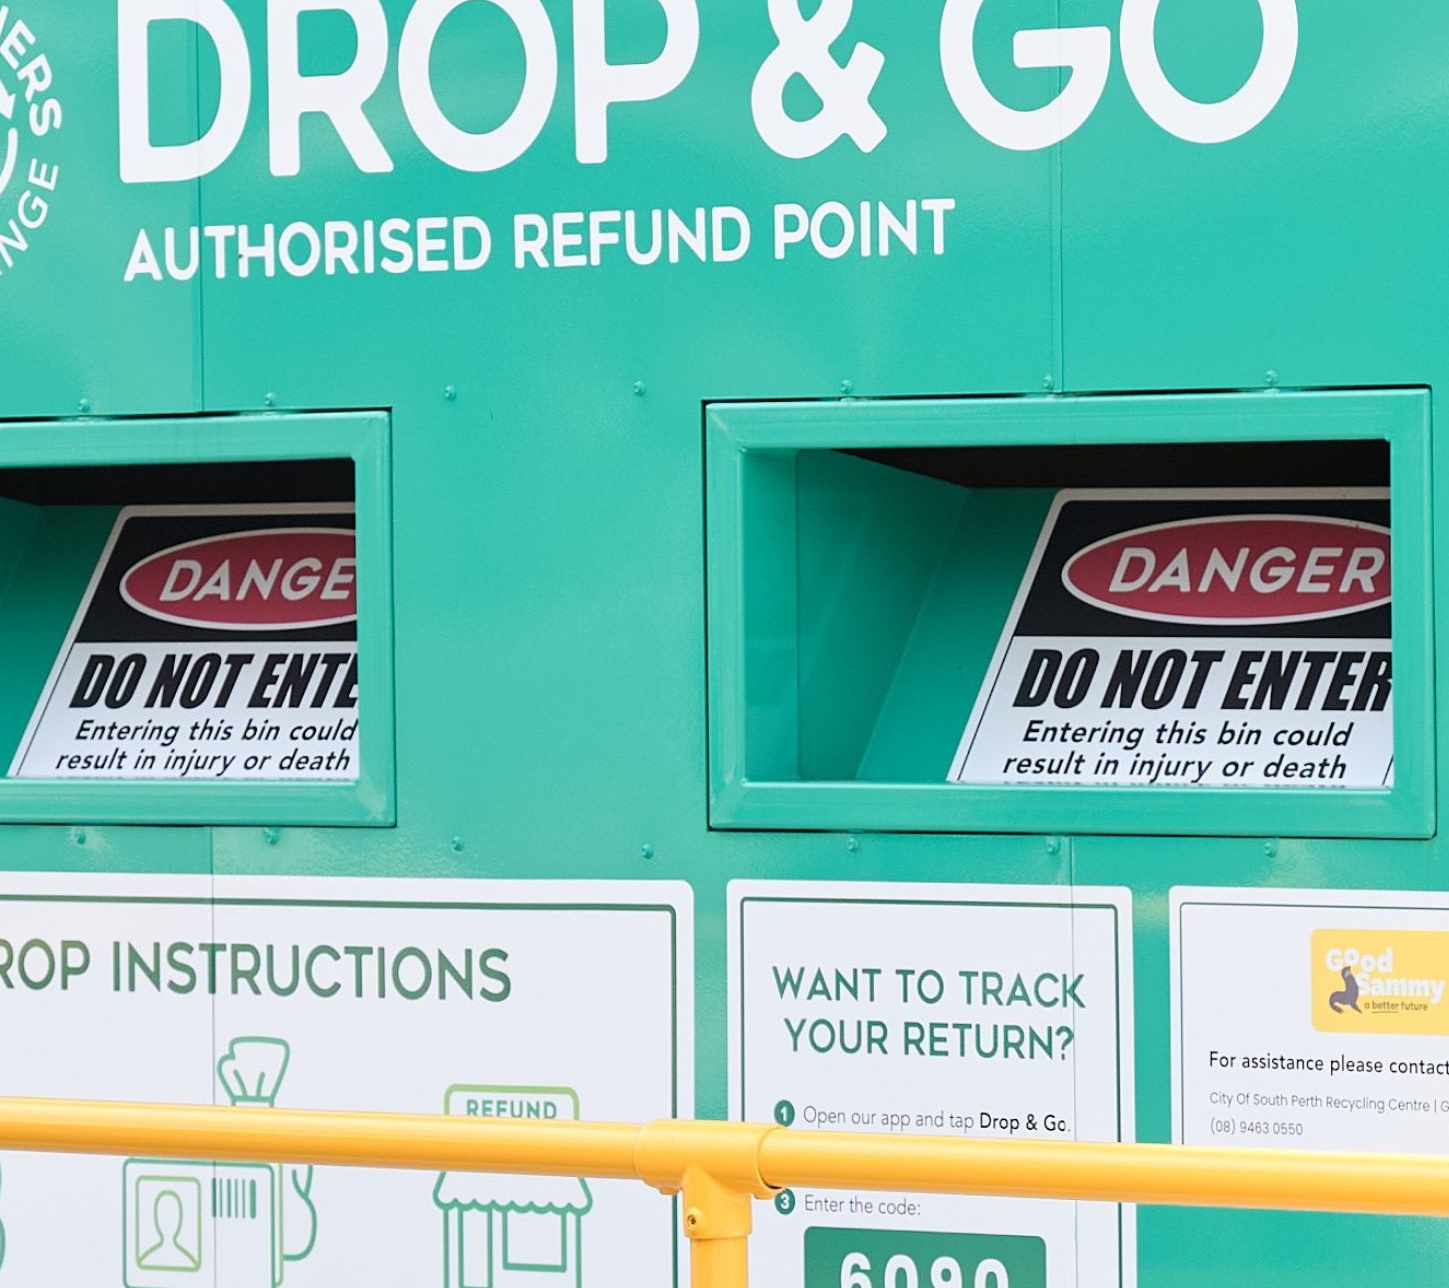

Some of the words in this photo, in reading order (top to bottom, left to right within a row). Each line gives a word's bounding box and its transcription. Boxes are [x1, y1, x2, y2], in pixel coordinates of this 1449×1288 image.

[124, 216, 491, 281] AUTHORISED
[514, 206, 750, 268] REFUND
[774, 199, 955, 259] POINT
[159, 558, 355, 601] DANGE
[1109, 547, 1384, 593] DANGER
[69, 653, 147, 709] DO
[145, 653, 253, 709] NOT
[1013, 649, 1100, 709] DO
[1100, 649, 1225, 710] NOT
[1221, 651, 1392, 711] ENTER
[76, 719, 180, 745] Entering
[189, 718, 233, 740] this
[242, 719, 280, 740] bin
[290, 718, 358, 740] could
[1023, 720, 1144, 750] Entering
[1156, 720, 1207, 744] this
[1217, 721, 1261, 745] bin
[1274, 722, 1354, 746] could
[1003, 752, 1085, 775] result
[1094, 752, 1118, 774] in
[1130, 753, 1212, 783] injury
[1223, 761, 1254, 777] or
[1264, 754, 1346, 778] death
[113, 941, 511, 1002] INSTRUCTIONS
[1325, 947, 1393, 972] Good
[772, 966, 882, 1002] WANT
[895, 969, 944, 1004] TO
[959, 971, 1085, 1009] TRACK
[1356, 972, 1445, 1004] Sammy
[784, 1018, 888, 1054] YOUR
[904, 1022, 1073, 1060] RETURN?
[1210, 1051, 1236, 1067] For
[1242, 1053, 1323, 1070] assistance
[1331, 1054, 1383, 1076] please
[467, 1099, 557, 1119] REFUND
[1210, 1092, 1233, 1108] City
[1237, 1092, 1249, 1105] Of
[1253, 1094, 1288, 1106] South
[1291, 1095, 1322, 1107] Perth
[1326, 1096, 1384, 1114] Recycling
[1389, 1098, 1430, 1112] Centre
[803, 1105, 846, 1128] Open
[851, 1112, 876, 1125] our
[881, 1113, 911, 1131] app
[915, 1110, 944, 1128] and
[950, 1114, 974, 1133] tap
[980, 1112, 1019, 1134] Drop
[1026, 1114, 1037, 1130] &
[1211, 1118, 1235, 1135] (08)
[1240, 1121, 1269, 1134] 9463
[1273, 1122, 1303, 1135] 0550
[805, 1194, 844, 1212] Enter
[849, 1196, 873, 1213] the
[878, 1198, 920, 1215] code:
